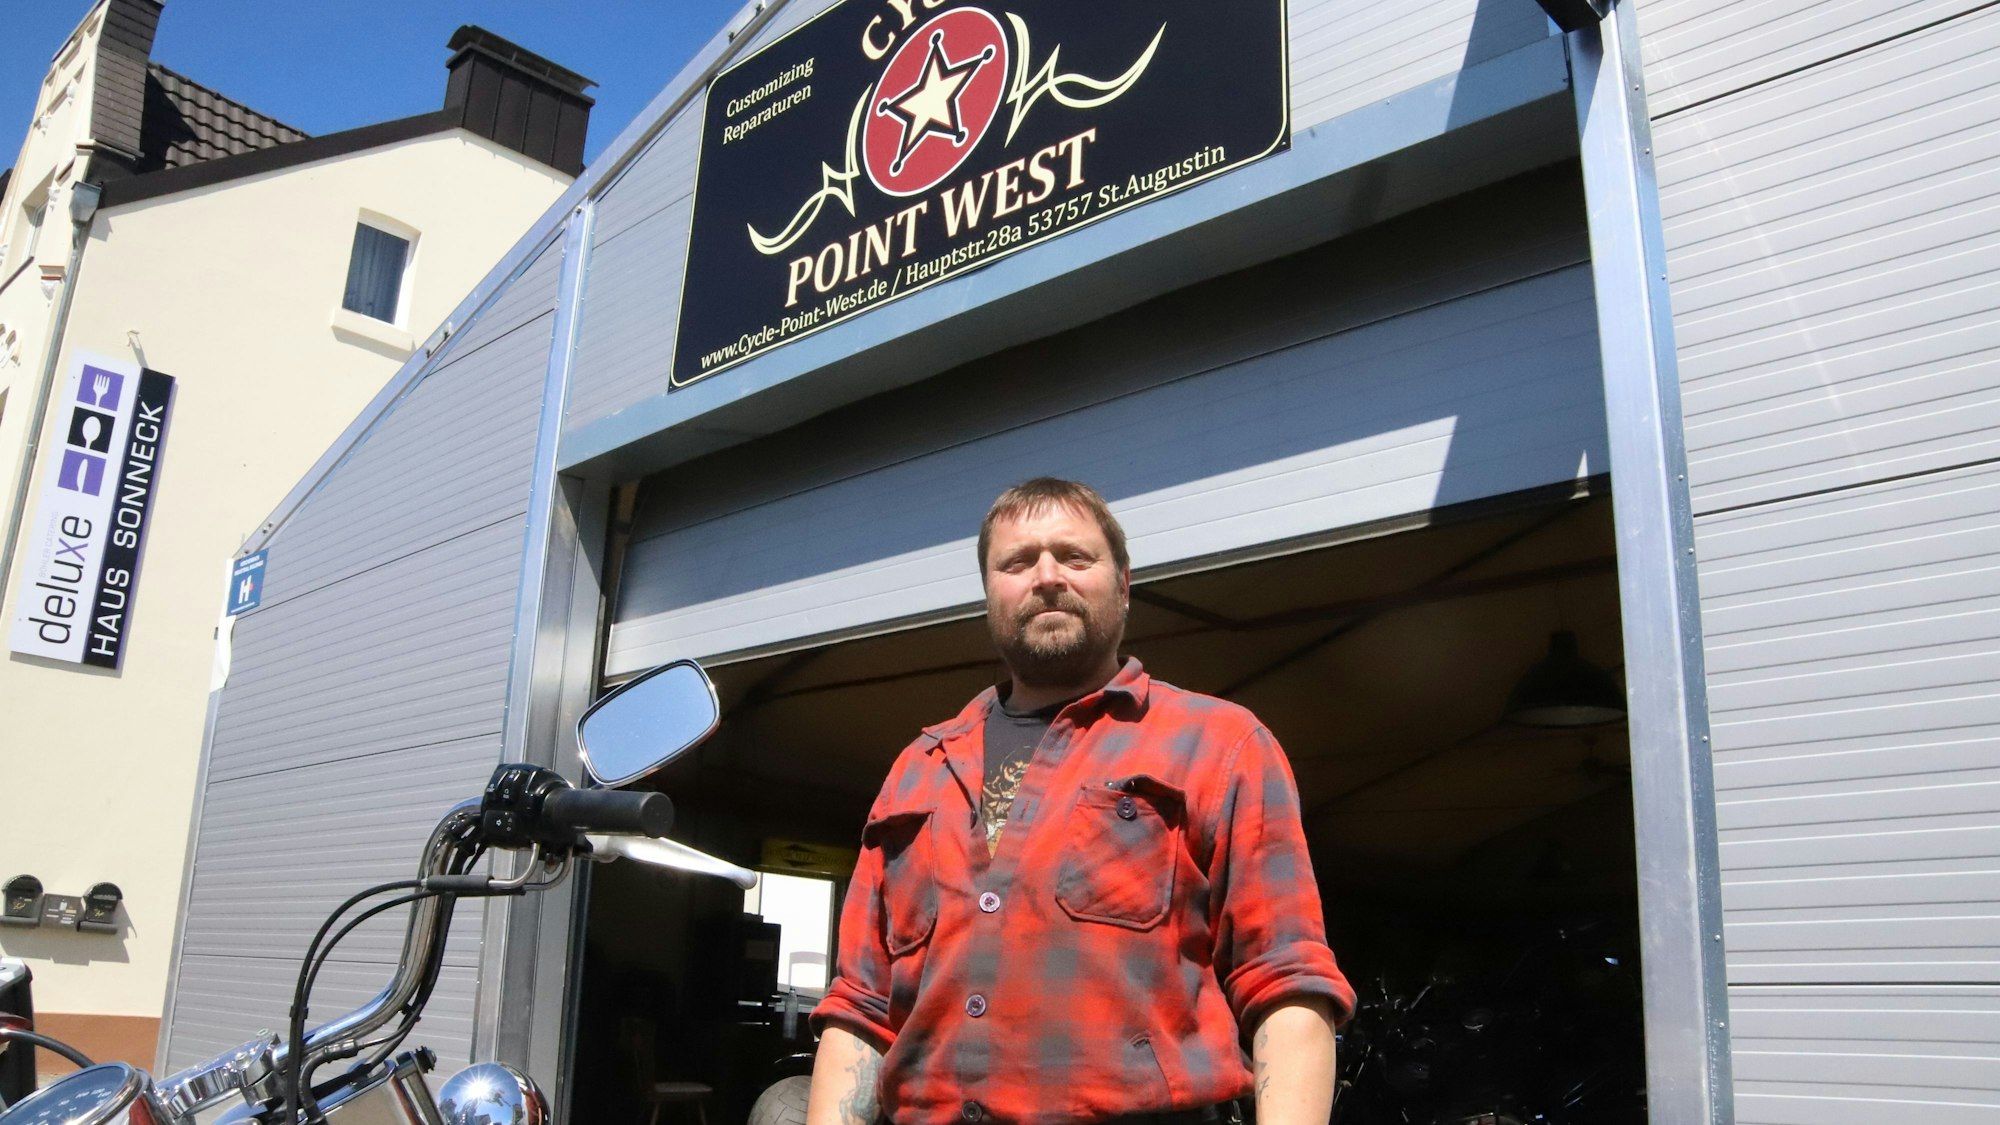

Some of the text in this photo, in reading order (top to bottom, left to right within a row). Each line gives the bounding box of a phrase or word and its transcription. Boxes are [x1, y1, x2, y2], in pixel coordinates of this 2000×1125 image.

[726, 57, 815, 118] Customizing
[862, 0, 946, 60] CY
[722, 84, 812, 145] Reparaturen
[700, 279, 888, 369] www.Cycle-Point-West.de
[905, 225, 1022, 286] Hauptstr.28a
[1027, 192, 1093, 236] 53757
[1098, 145, 1226, 209] St.Augustin
[785, 128, 1096, 307] POINT WEST
[28, 515, 92, 644] deluxe
[91, 401, 164, 656] HAUS SONNECK
